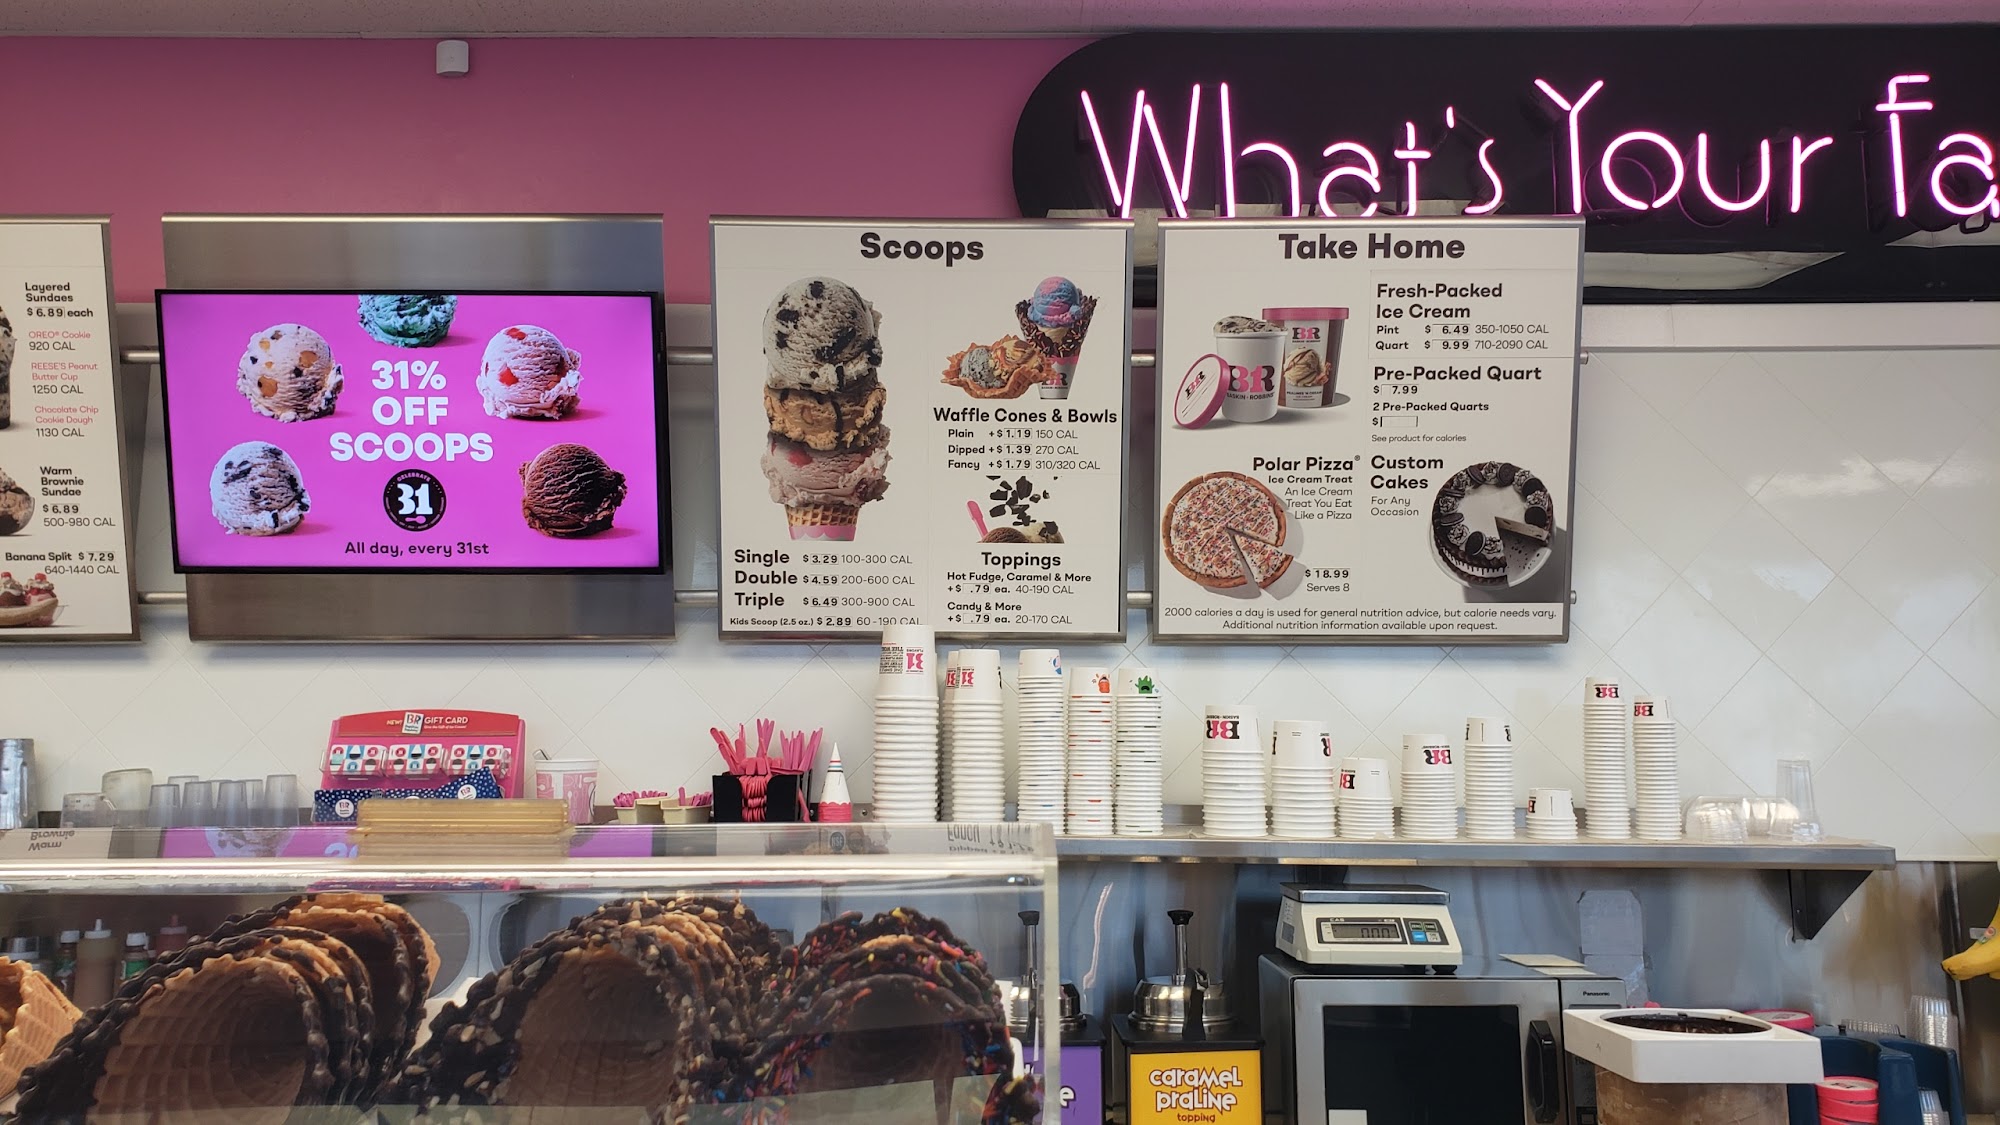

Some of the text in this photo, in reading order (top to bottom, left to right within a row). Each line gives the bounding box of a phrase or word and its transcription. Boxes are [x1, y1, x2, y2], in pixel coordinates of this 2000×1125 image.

[1534, 76, 1834, 214] Your
[860, 232, 984, 268] Scoops
[1278, 234, 1465, 259] Take Home
[25, 282, 70, 293] Layered
[1377, 283, 1502, 298] Fresh-Packed
[26, 293, 74, 302] Sundaes
[67, 308, 94, 317] each
[1376, 304, 1471, 319] Ice Cream
[1376, 325, 1399, 334] Pint
[1475, 324, 1524, 334] 350-1050
[1526, 324, 1549, 334] CAL
[29, 342, 75, 350] 920 CAL
[1376, 341, 1408, 350] Quart
[1474, 340, 1523, 349] 710-2090
[1526, 340, 1548, 349] CAL
[32, 362, 66, 370] REESE'S
[32, 373, 78, 382] Butter Cup
[372, 361, 446, 390] 31%
[1374, 366, 1542, 381] Pre-Packed Quart
[1228, 366, 1275, 392] BR
[32, 385, 84, 394] 1250 CAL
[34, 406, 99, 415] Chocolate Chip
[373, 397, 448, 425] OFF
[1373, 402, 1489, 412] 2 Pre-Packed Quarts
[934, 408, 1117, 423] Waffle Cones & Bowls
[36, 416, 93, 426] Cookie Dough
[36, 428, 84, 437] 1130 CAL
[948, 429, 1078, 438] Plain 150 CAL
[1389, 434, 1420, 443] product
[1422, 434, 1433, 442] for
[1436, 434, 1466, 442] calories
[330, 432, 494, 462] SCOOPS
[948, 445, 1078, 455] Dipped 270 CAL
[948, 460, 1100, 470] Fancy 310/320 CAL
[1253, 457, 1300, 470] Polar
[1371, 456, 1444, 469] Custom
[40, 467, 72, 475] Warm
[41, 477, 84, 486] Brownie
[397, 472, 431, 482] CELEBRATE
[1268, 475, 1352, 483] Ice Cream Treat
[1371, 475, 1428, 489] Cakes
[42, 488, 81, 496] Sundae
[1285, 487, 1352, 496] An Ice Cream
[398, 484, 432, 514] 31
[1287, 499, 1352, 507] Treat You Eat
[1371, 497, 1410, 507] For Any
[1294, 511, 1314, 520] Like
[1326, 511, 1352, 520] Pizza
[1371, 508, 1419, 516] Occasion
[44, 518, 116, 526] 500-980 CAL
[345, 542, 489, 558] All day, every 31st
[5, 552, 72, 563] Banana Split
[735, 550, 912, 567] Single 100-300 CAL
[981, 552, 1061, 569] Toppings
[44, 566, 120, 574] 640-1440 CAL
[735, 570, 915, 584] Double 200-600 CAL
[948, 572, 966, 581] Hot
[969, 573, 1004, 583] Fudge,
[1007, 573, 1051, 581] Caramel
[1065, 574, 1092, 582] More
[1306, 583, 1350, 592] Serves 8
[734, 592, 915, 610] Triple 300-900 CAL
[947, 602, 982, 612] Candy
[1165, 608, 1556, 619] 2000 calories a day is used for general nutrition advice, but calorie needs vary.
[1223, 621, 1497, 632] Additional nutrition information available upon request.
[906, 653, 923, 669] 31
[424, 716, 442, 724] GIFT
[1206, 720, 1240, 739] BR
[1424, 750, 1452, 765] BR
